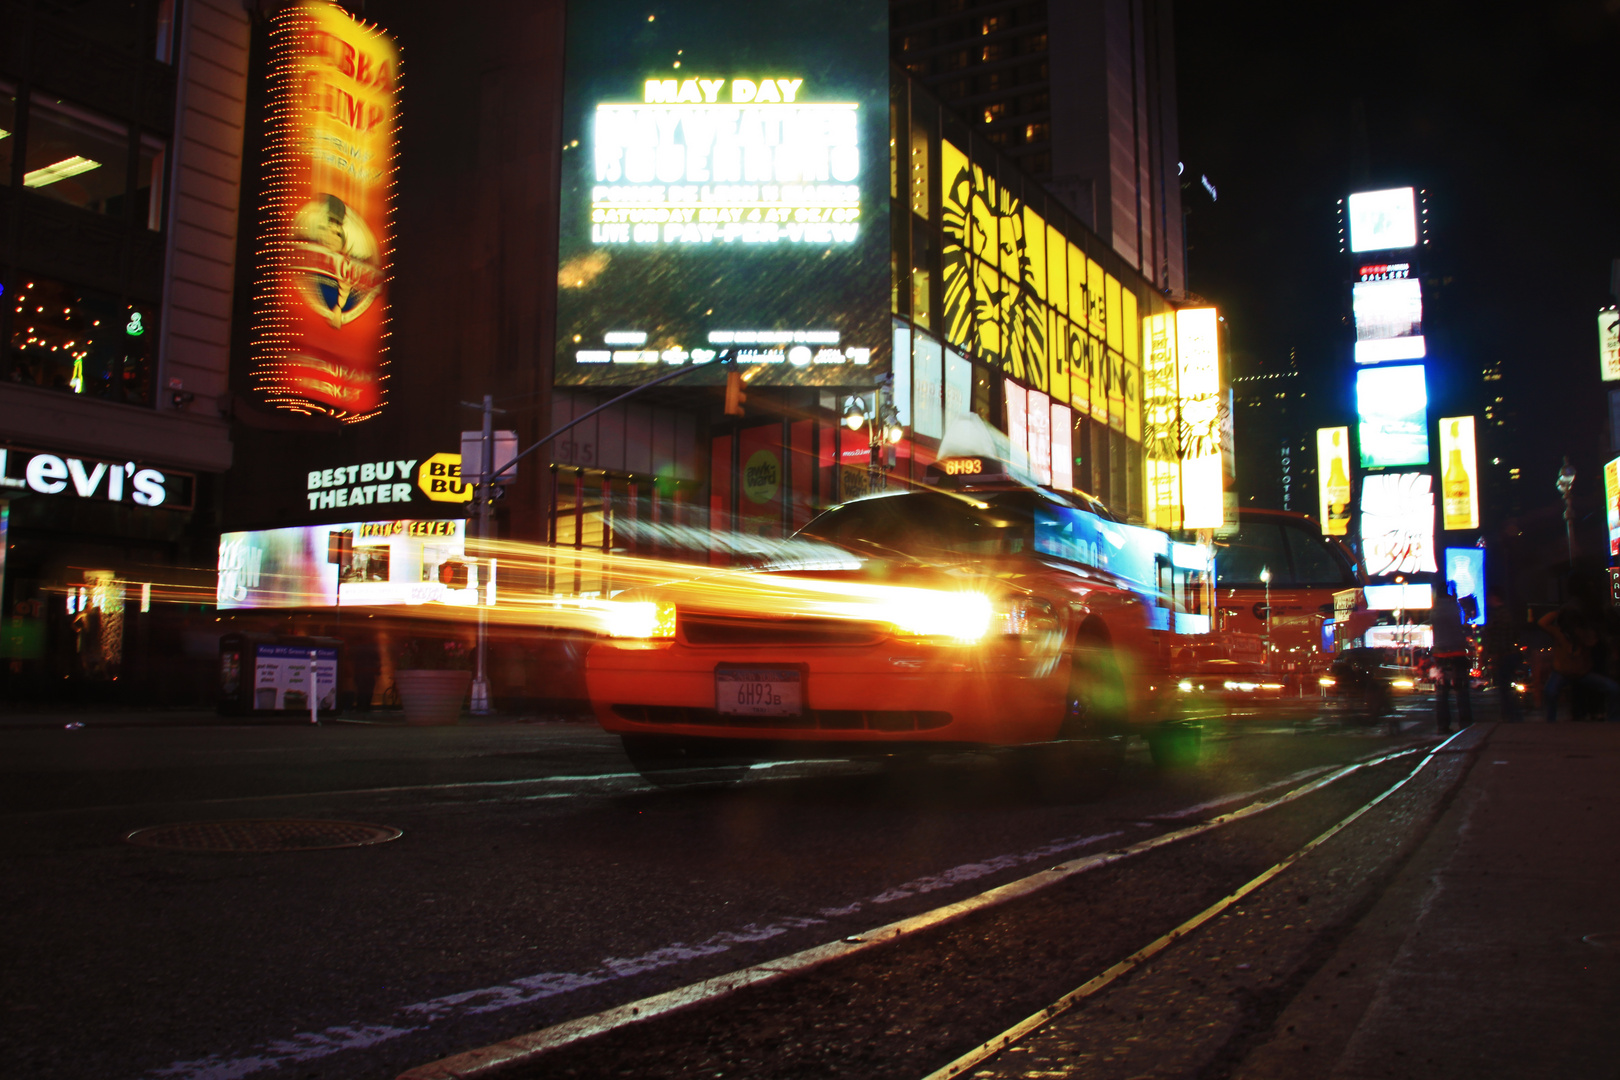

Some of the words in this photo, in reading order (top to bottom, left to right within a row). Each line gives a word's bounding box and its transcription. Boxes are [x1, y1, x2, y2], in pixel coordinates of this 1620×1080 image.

[300, 30, 393, 96] BBA
[644, 77, 725, 103] MAY
[732, 78, 804, 103] DAY
[592, 208, 696, 222] SATURDAY
[698, 208, 744, 222] MAY
[764, 208, 792, 222] AT
[592, 223, 630, 243] LIVE
[633, 223, 659, 243] ON
[664, 222, 860, 243] PAY-PER-VIEW
[1360, 270, 1410, 282] GALLERY
[1080, 282, 1106, 323] THE
[307, 465, 360, 490] BEST
[360, 460, 418, 483] BUY
[430, 462, 462, 477] BE
[946, 459, 982, 475] 6H93
[431, 478, 467, 494] BU
[1281, 447, 1292, 512] NOVOTEL
[307, 483, 412, 511] THEATER
[359, 520, 403, 538] SPRING
[409, 521, 457, 537] FEVER
